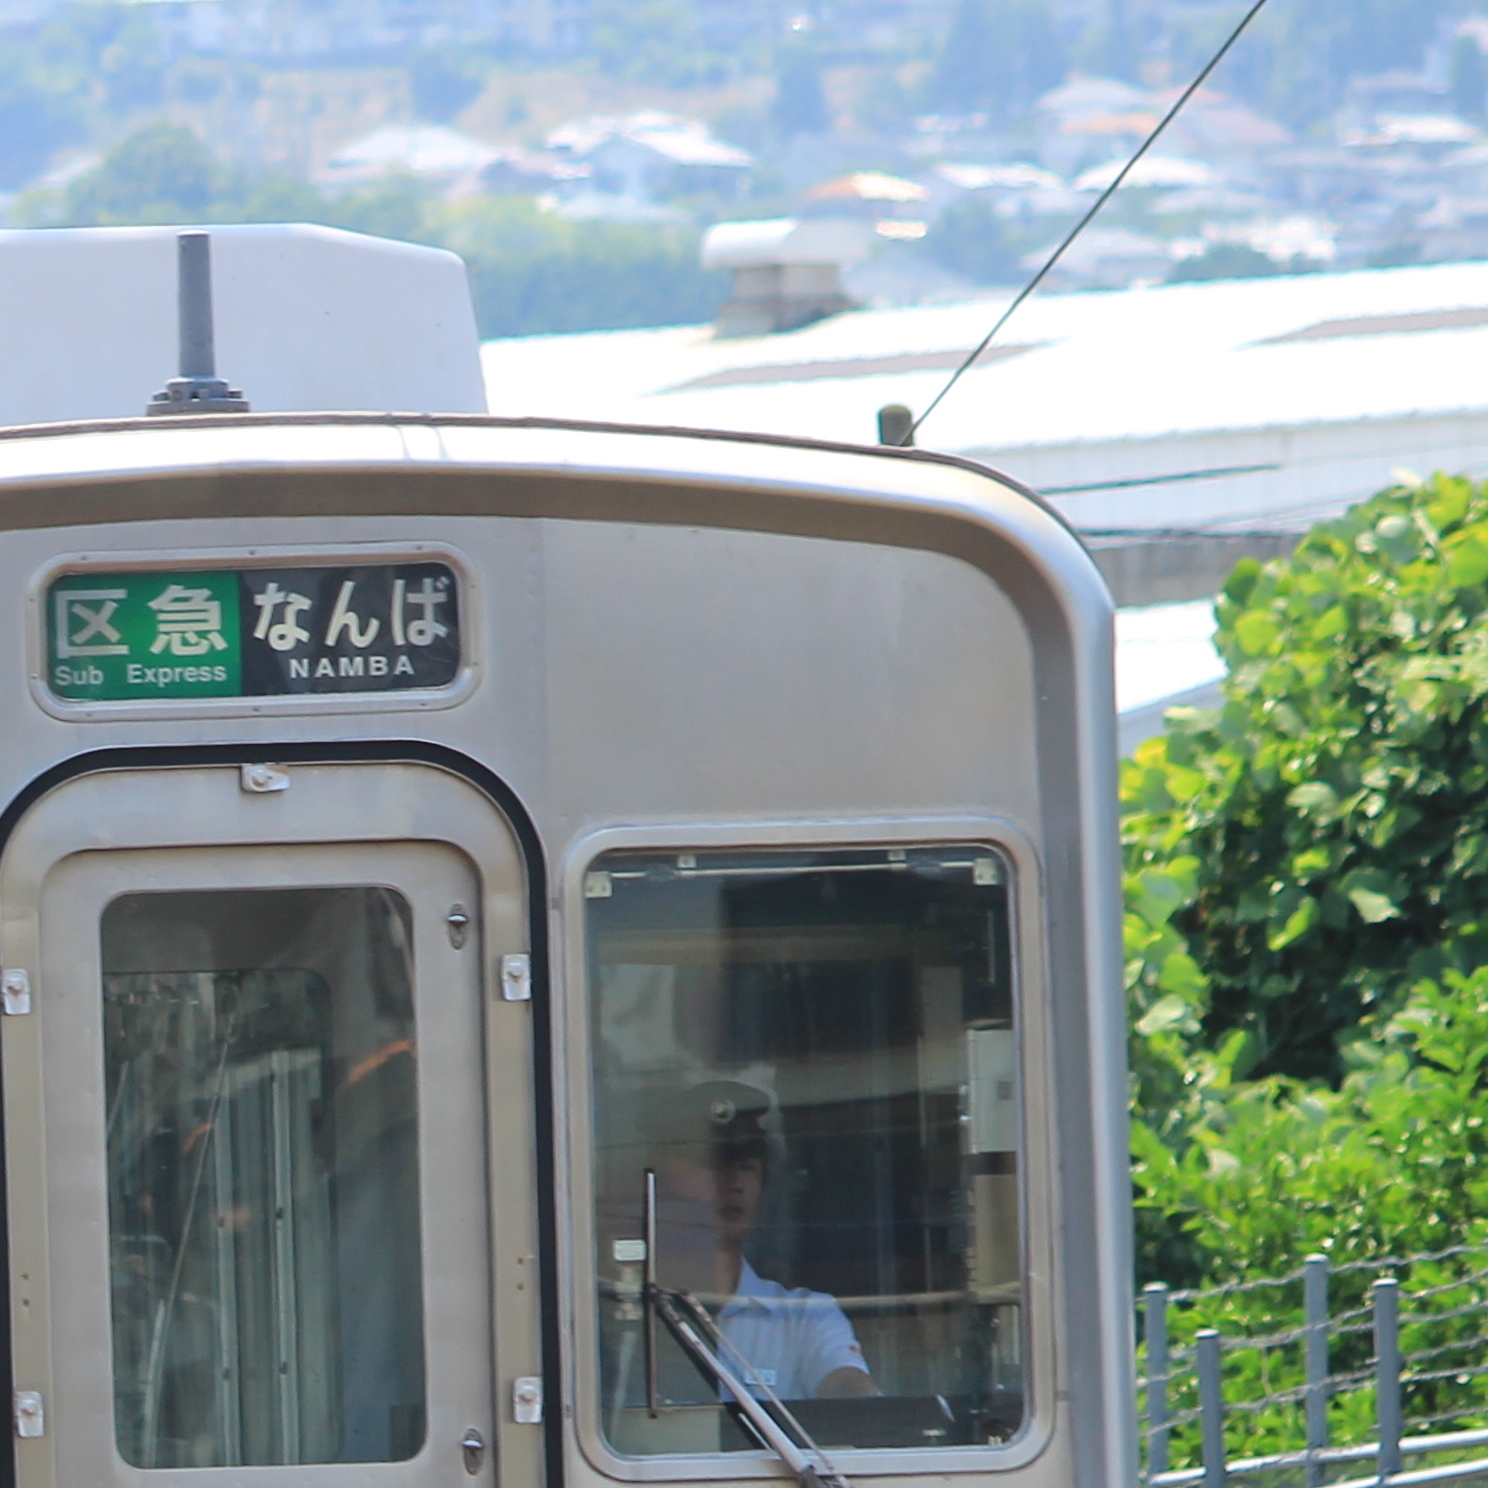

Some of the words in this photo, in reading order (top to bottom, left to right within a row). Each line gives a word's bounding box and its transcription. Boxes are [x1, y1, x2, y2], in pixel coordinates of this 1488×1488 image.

[55, 584, 229, 659] 区急
[253, 575, 451, 652] なんば
[54, 665, 105, 686] Sub
[126, 663, 228, 685] Express
[289, 656, 416, 680] NAMBA
